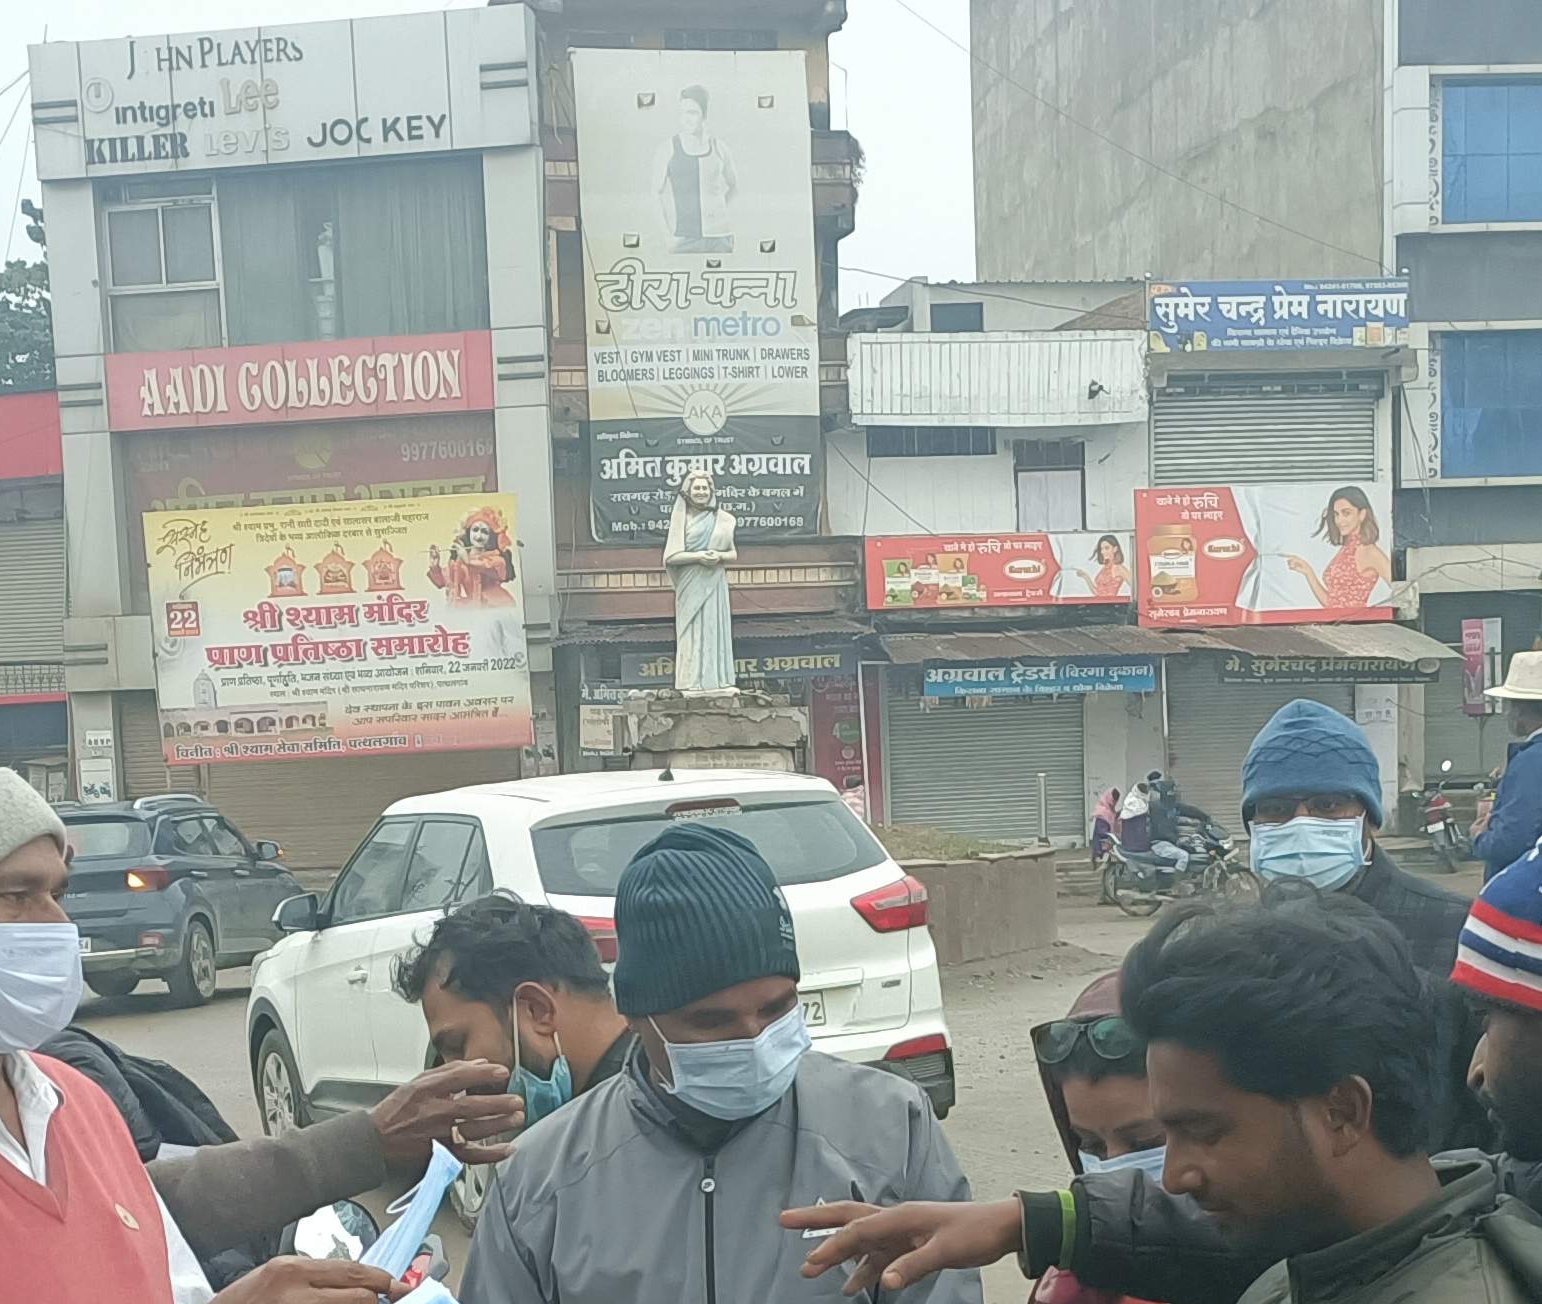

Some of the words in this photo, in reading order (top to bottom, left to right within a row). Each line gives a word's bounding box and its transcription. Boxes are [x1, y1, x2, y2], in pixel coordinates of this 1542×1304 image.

[199, 37, 304, 69] PLAYERS
[85, 131, 190, 165] KILLER
[1154, 287, 1211, 334] सुमेर
[1217, 296, 1266, 326] चन्द्र
[1272, 286, 1310, 319] प्रेम
[1316, 293, 1408, 319] नारायण
[694, 311, 781, 337] metro
[594, 351, 620, 364] VEST
[631, 350, 654, 363] GYM
[656, 350, 682, 362] VEST
[692, 349, 714, 362] MINI
[715, 349, 751, 361] TRUNK
[760, 348, 810, 361] DRAWERS
[139, 364, 229, 418] AADI
[237, 348, 462, 413] COLLECTION
[597, 368, 655, 383] BLOOMERS
[662, 366, 715, 380] LEGGINGS
[723, 366, 760, 379] T-SHIRT
[771, 366, 808, 379] LOWER
[685, 404, 725, 429] AKA
[599, 448, 662, 480] अमित
[729, 453, 812, 477] अग्रवाल
[1192, 492, 1219, 510] रुचि
[735, 516, 804, 528] 977600168
[977, 539, 1002, 554] रुचि
[169, 610, 198, 629] 22
[243, 602, 280, 630] श्री
[285, 602, 357, 628] श्याम
[362, 593, 428, 624] मंदिर
[206, 645, 267, 668] प्राण
[271, 633, 366, 665] प्रतिष्ठा
[371, 625, 471, 658] समारोह
[448, 661, 461, 674] 22
[491, 657, 516, 671] 2022
[639, 656, 675, 678] अमि
[762, 654, 841, 672] अग्रवाल
[925, 665, 1006, 684] अग्रवाल
[1011, 660, 1058, 685] ट्रेडर्स
[241, 743, 274, 756] श्याम
[275, 739, 301, 753] सेवा
